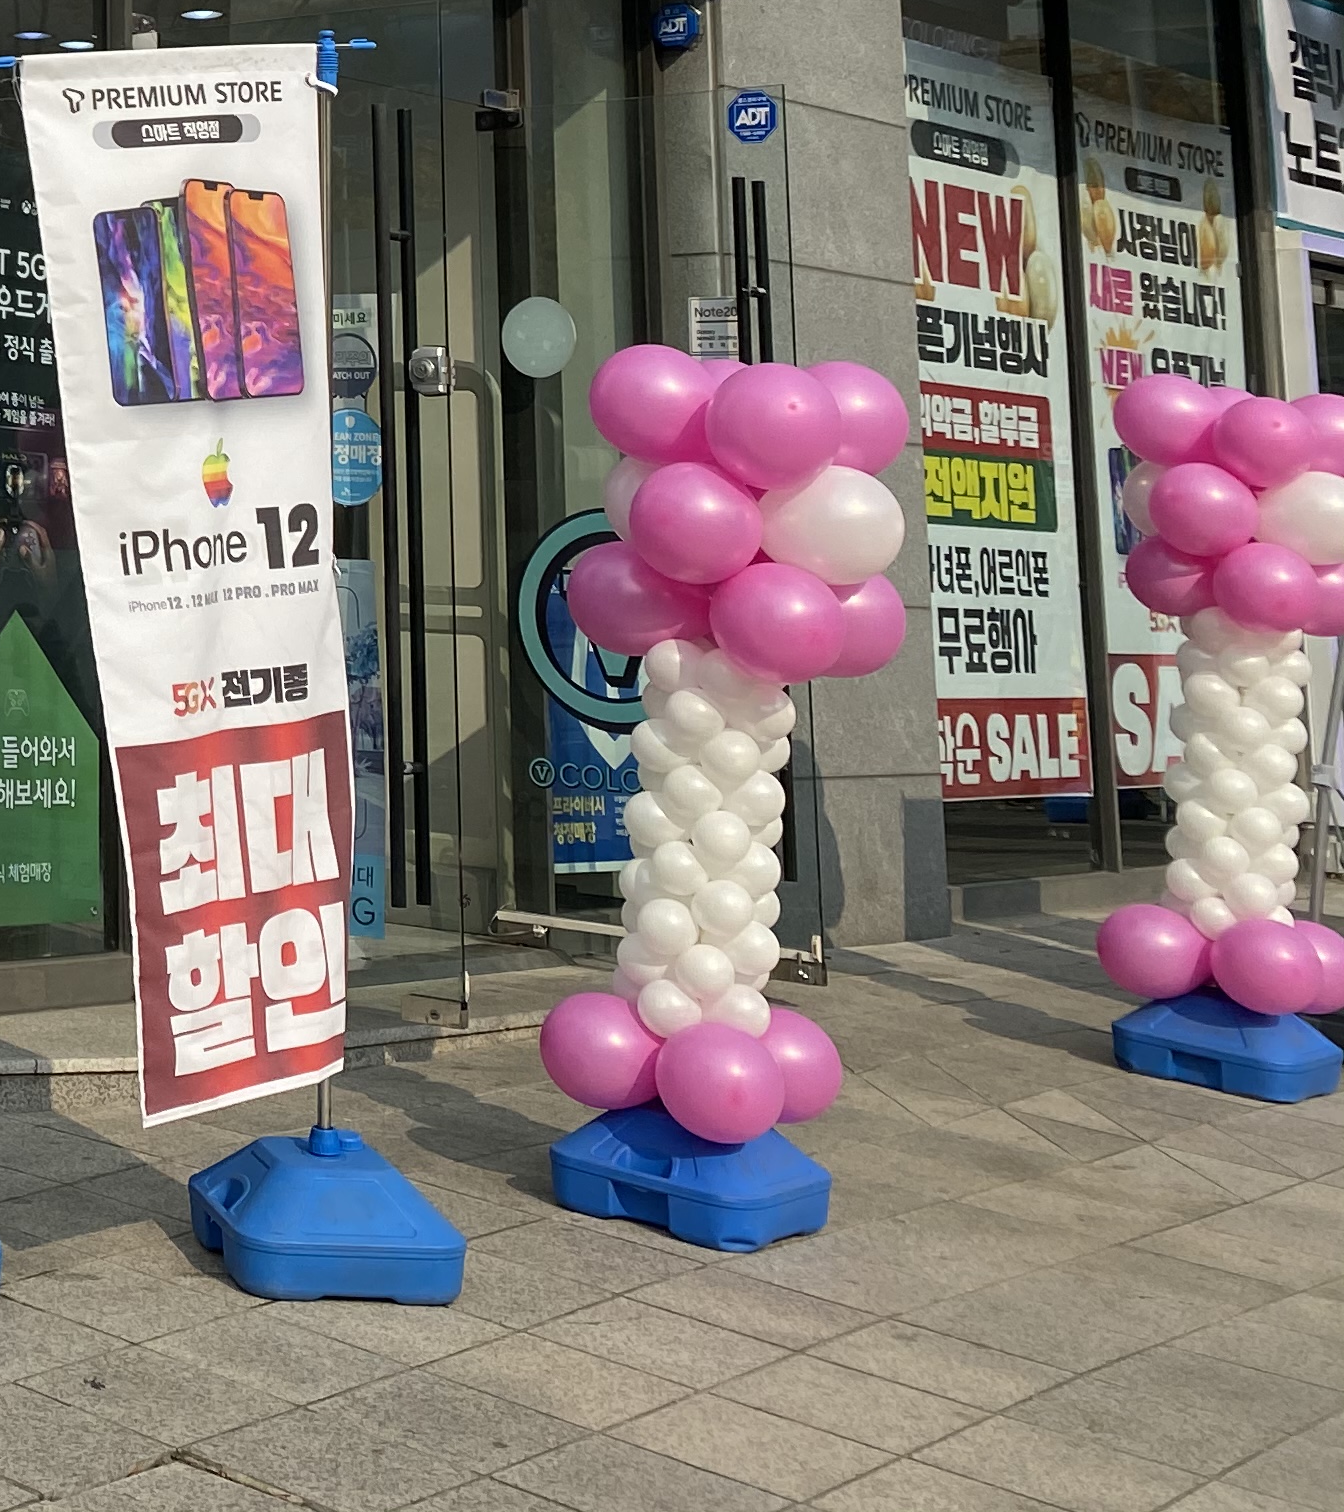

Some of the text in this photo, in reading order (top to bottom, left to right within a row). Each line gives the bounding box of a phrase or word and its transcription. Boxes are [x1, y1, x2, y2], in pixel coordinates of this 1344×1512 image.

[659, 17, 687, 34] ADT
[92, 80, 283, 110] PREMIUM STORE
[984, 96, 1034, 132] STORE
[141, 120, 220, 143] 스마트 직영점
[735, 107, 769, 127] ADT
[932, 132, 960, 158] 스마트
[1095, 120, 1224, 177] PREMIUM STORE
[909, 176, 1024, 300] NEW
[1117, 209, 1197, 269] 사장님이
[1090, 264, 1226, 331] 새로 왔습니다!
[333, 312, 367, 326] 미세요
[3, 333, 35, 362] 정식
[1100, 348, 1143, 388] NEW
[925, 456, 1035, 524] 전액지원
[119, 502, 320, 576] iPhone 12
[235, 578, 319, 601] PRO MAX
[938, 607, 1037, 674] 무료행사
[171, 662, 308, 717] 5GX 전기종
[1, 735, 76, 769] 들어와서
[987, 713, 1080, 782] SALE
[156, 748, 340, 916] 최대
[8, 862, 52, 884] 체험매장
[165, 901, 346, 1077] 할인
